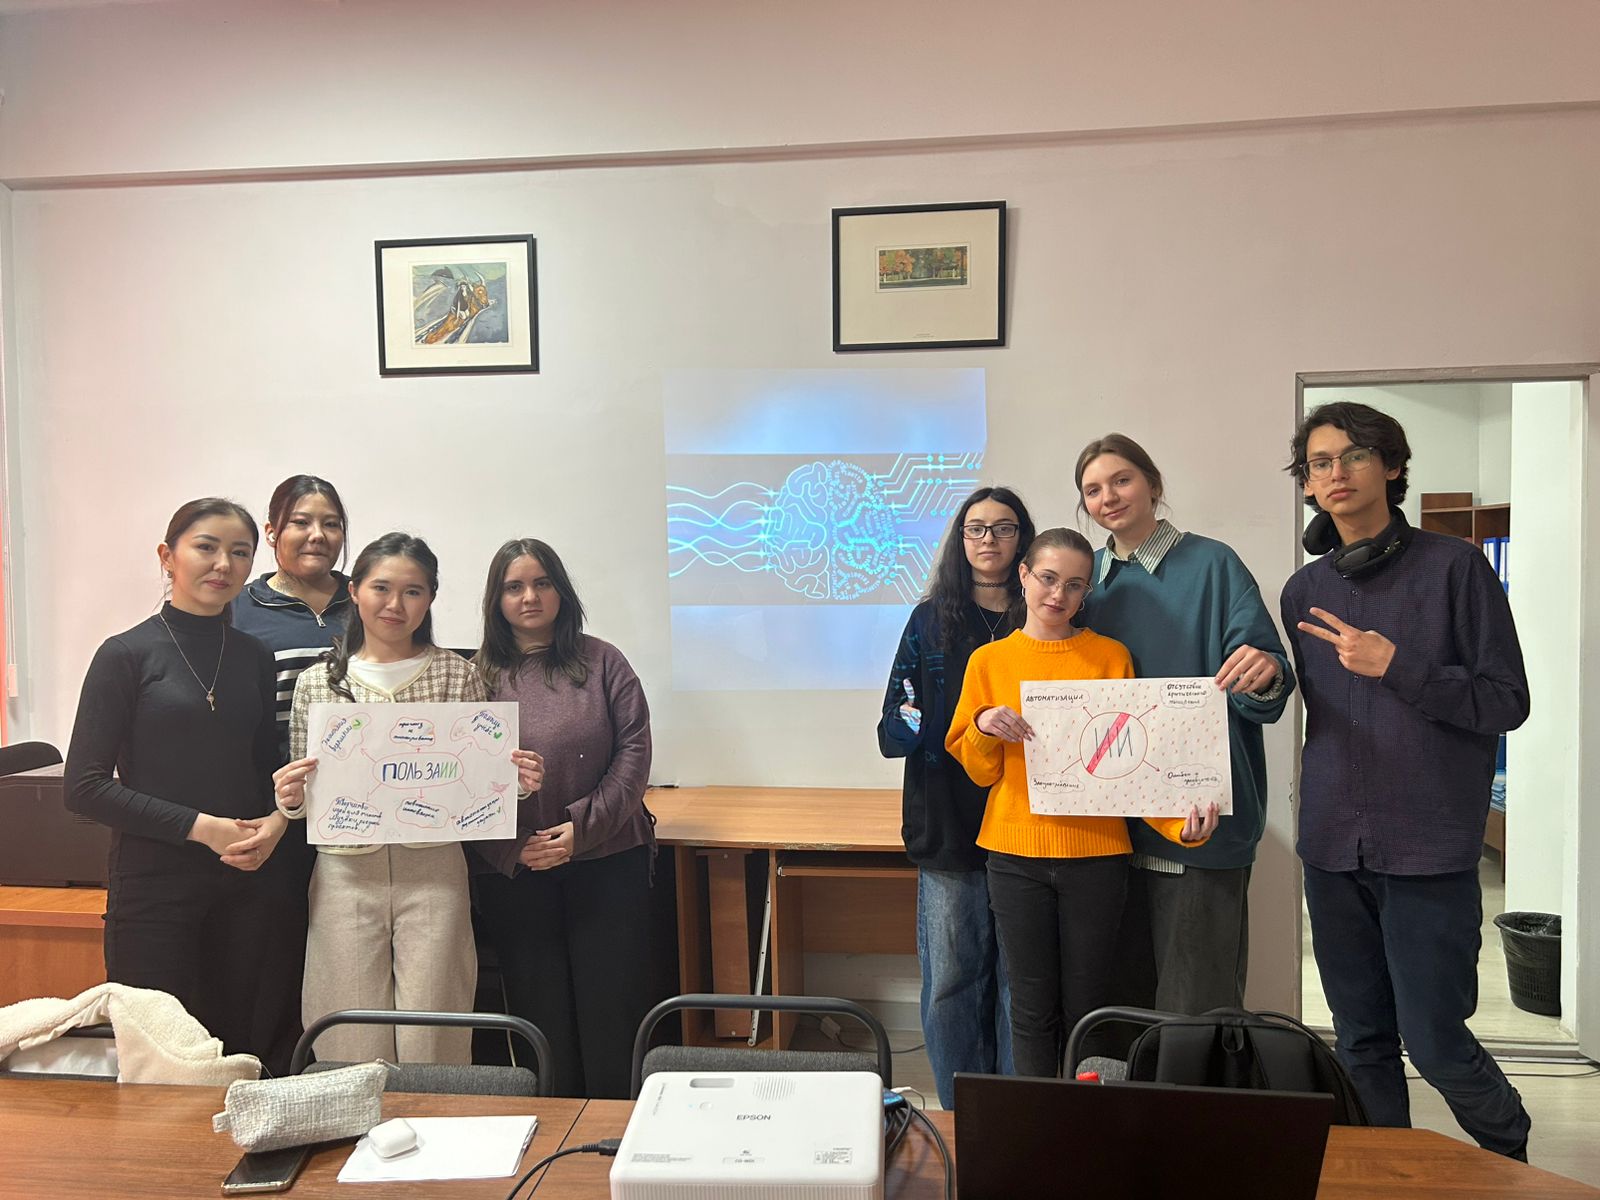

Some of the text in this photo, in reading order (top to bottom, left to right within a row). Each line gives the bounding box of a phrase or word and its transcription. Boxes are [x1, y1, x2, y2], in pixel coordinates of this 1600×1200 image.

[1025, 694, 1084, 704] АВТОМАТИЗАЦИЯ
[1094, 725, 1133, 760] ИИ
[736, 1113, 771, 1121] EPSON
